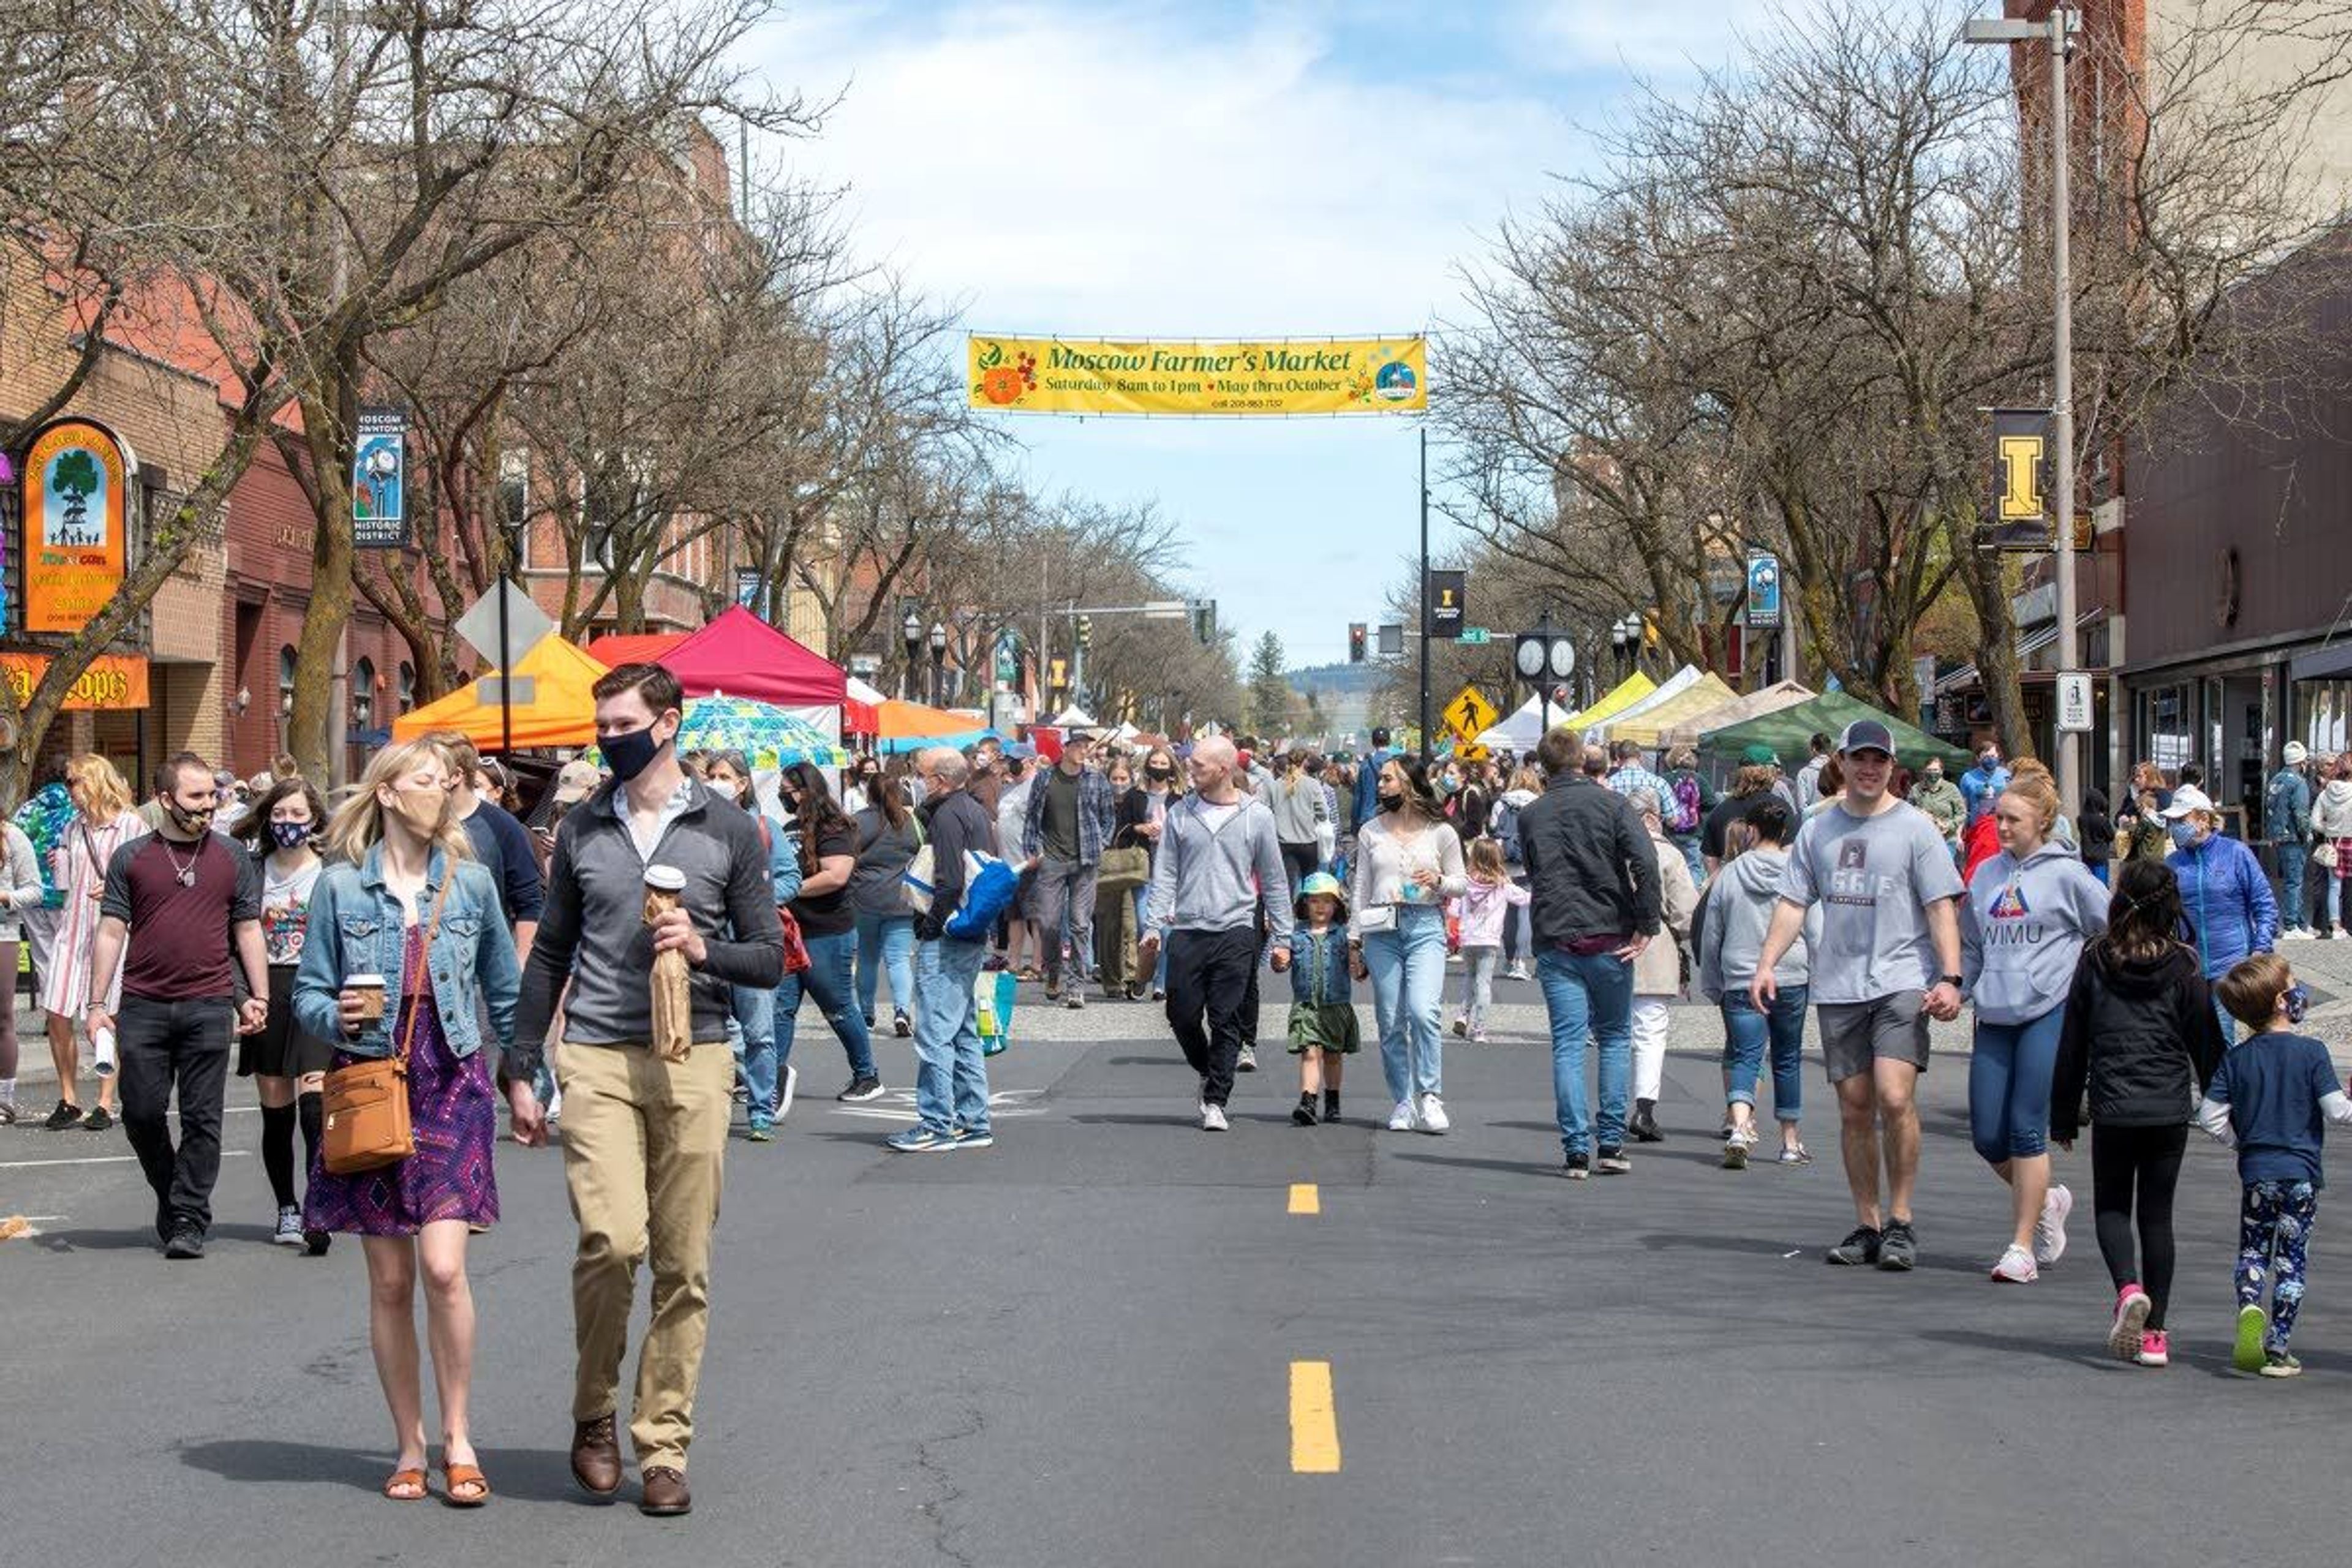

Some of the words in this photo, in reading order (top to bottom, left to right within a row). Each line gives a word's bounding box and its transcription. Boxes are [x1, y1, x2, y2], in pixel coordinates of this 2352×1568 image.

[1046, 349, 1145, 370] Moscow
[1150, 350, 1257, 372] Farmer's
[1262, 350, 1351, 372] Market
[1046, 377, 1111, 394] Saturday
[1117, 379, 1148, 392] 8am
[1152, 380, 1165, 392] to
[1170, 380, 1202, 394] 1pm
[1217, 380, 1250, 394] May
[1253, 379, 1283, 392] thru
[1286, 379, 1341, 392] October
[1999, 435, 2043, 520] I
[355, 521, 401, 530] HISTORIC
[355, 531, 401, 540] DISTRICT
[1983, 925, 2043, 945] WIMU
